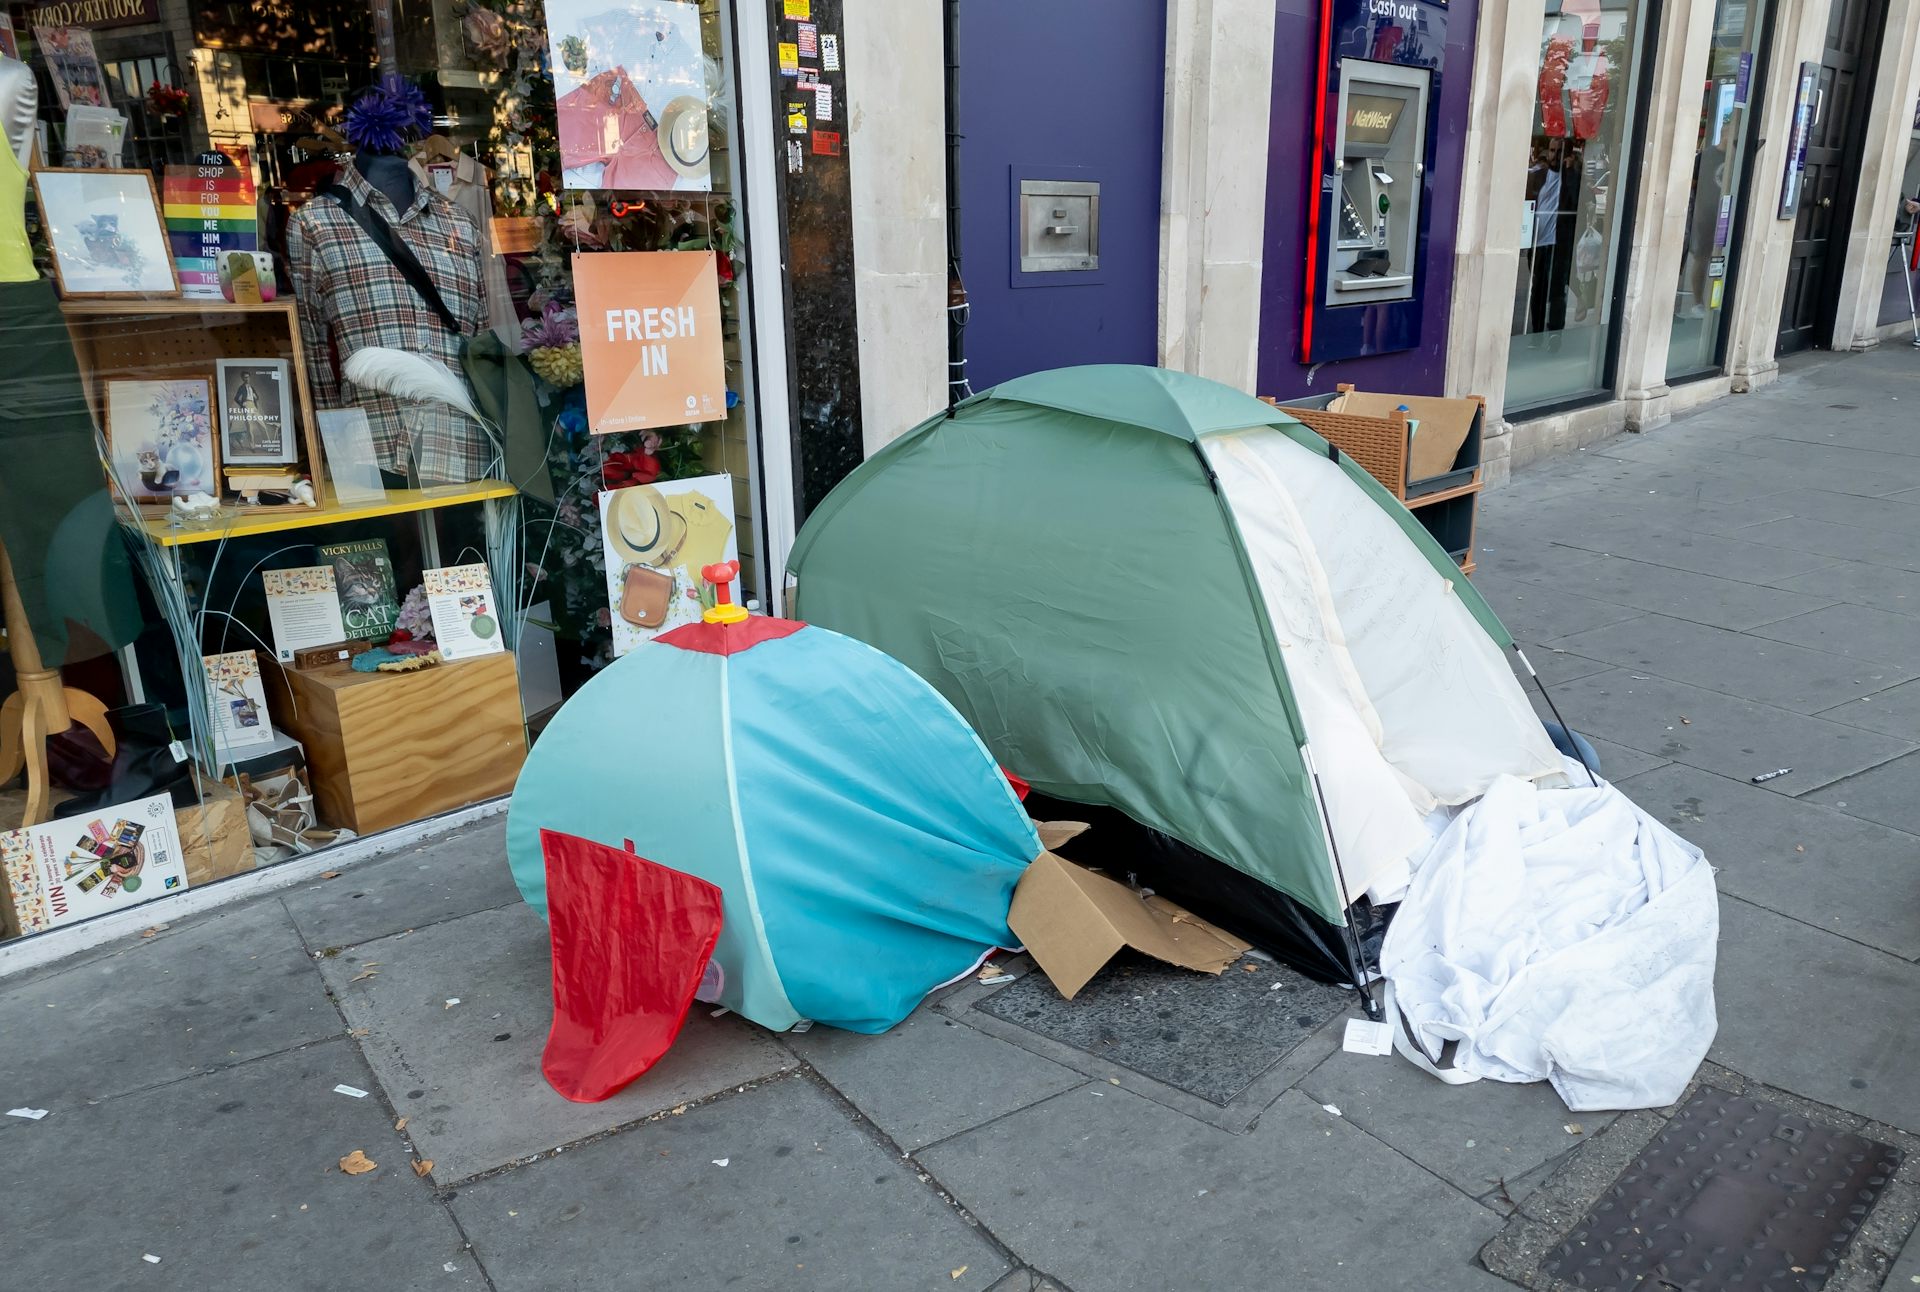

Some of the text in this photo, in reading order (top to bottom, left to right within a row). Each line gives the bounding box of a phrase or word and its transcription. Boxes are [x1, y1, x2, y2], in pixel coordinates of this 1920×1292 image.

[1369, 0, 1418, 21] Cash out
[1352, 110, 1392, 128] NatWest
[201, 154, 223, 165] THIS
[198, 166, 224, 178] SHOP
[205, 179, 215, 191] IS
[200, 192, 220, 204] FOR
[200, 206, 220, 217] YOU
[203, 219, 218, 231] ME
[202, 232, 220, 244] HIM
[606, 306, 695, 342] FRESH
[642, 344, 669, 377] IN
[321, 541, 383, 556] VICKY HALLS
[345, 604, 391, 629] CAT
[48, 885, 69, 917] WIN
